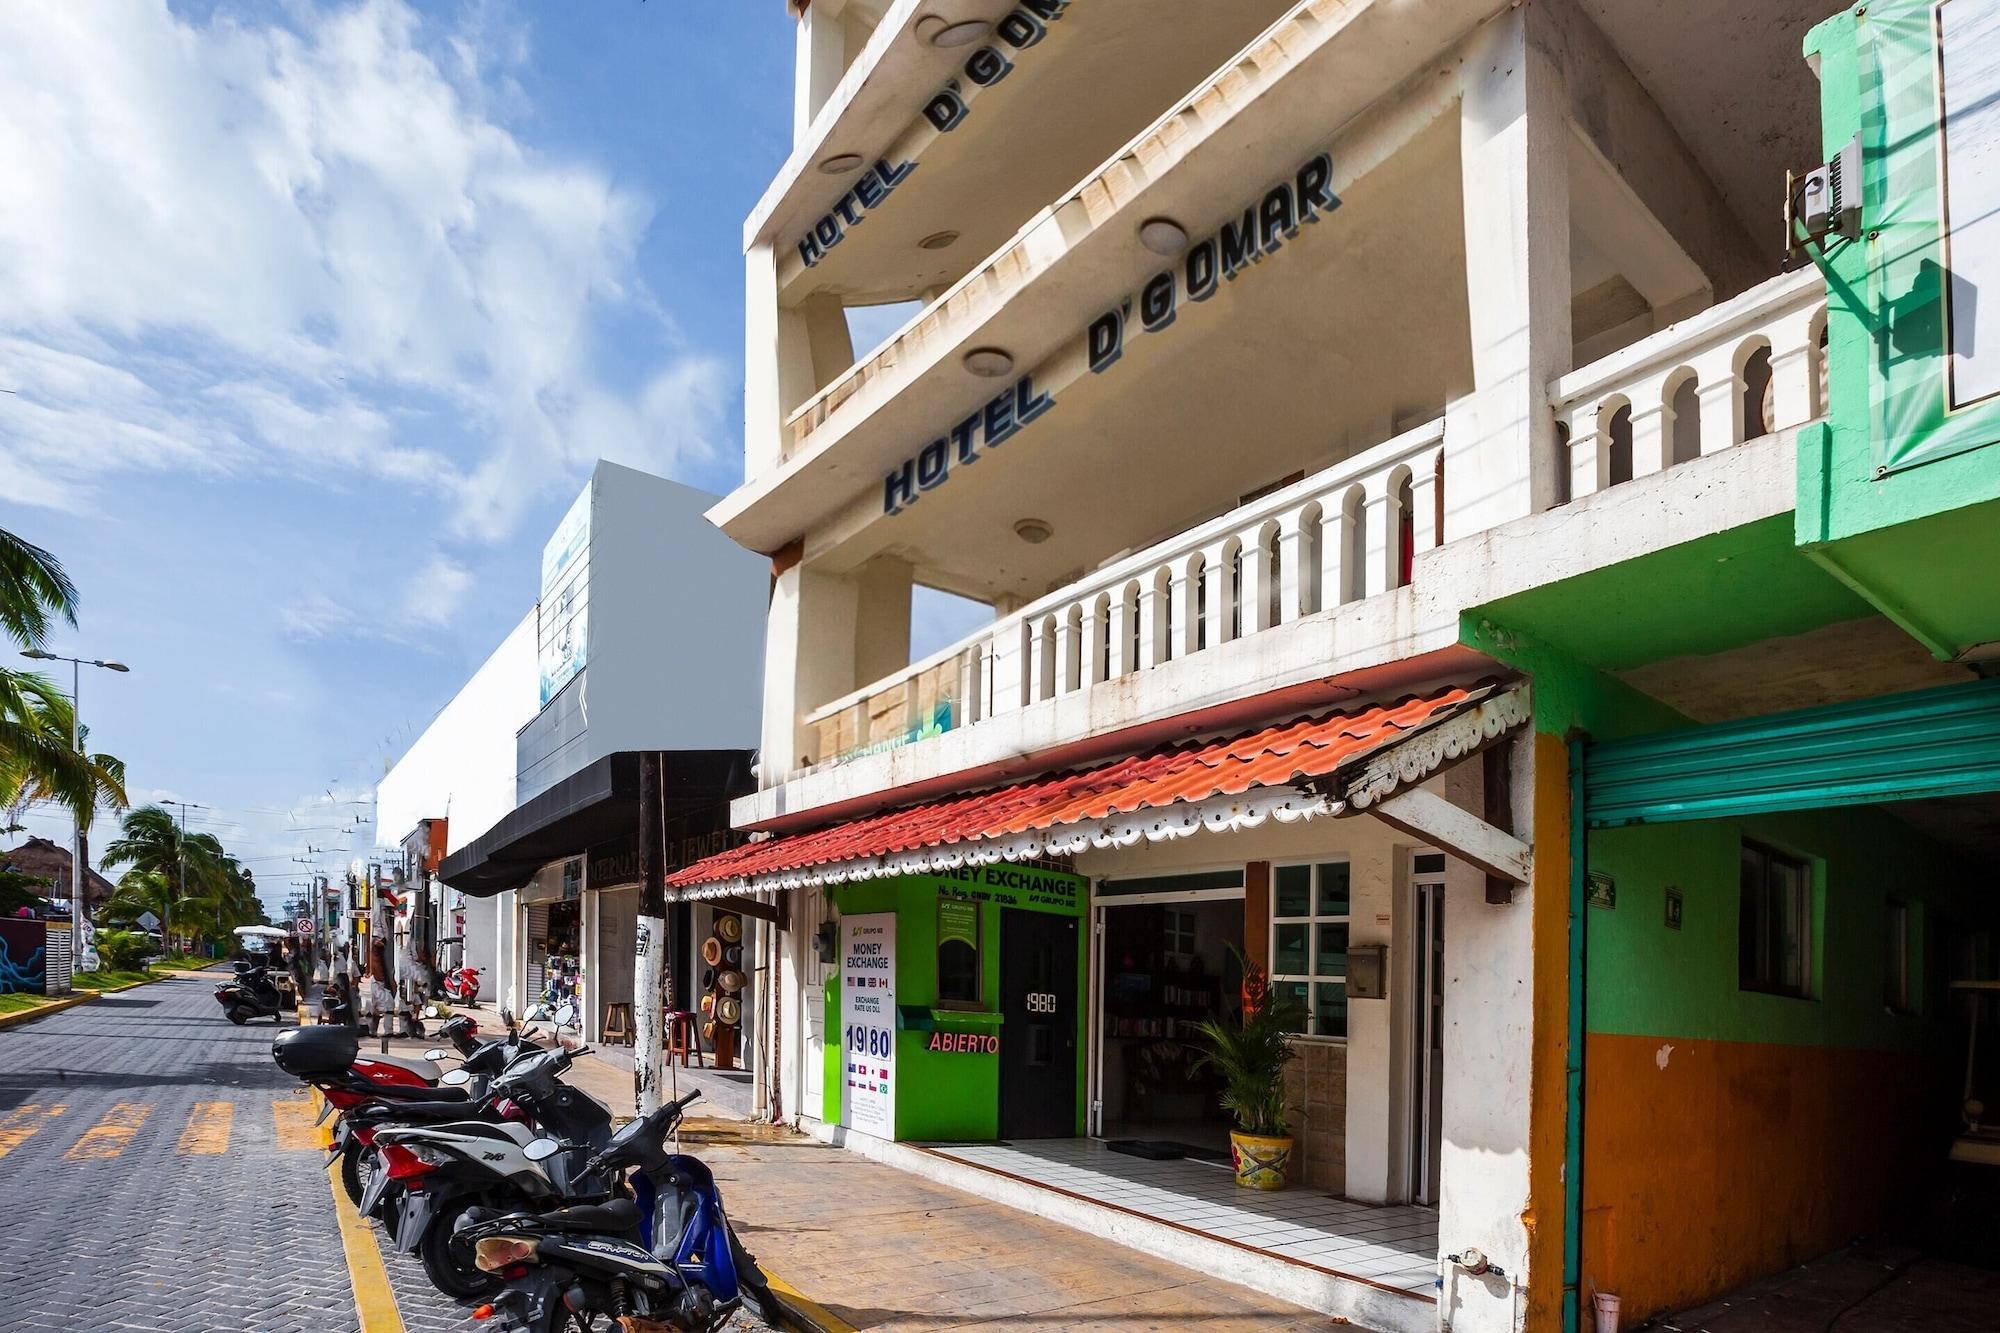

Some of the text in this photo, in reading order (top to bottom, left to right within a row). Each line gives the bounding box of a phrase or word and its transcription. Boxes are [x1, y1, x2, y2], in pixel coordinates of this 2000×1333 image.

[798, 157, 918, 269] HOTEL
[883, 152, 1344, 516] HOTEL D'GOMAR
[985, 868, 1077, 897] EXCHANGE
[1040, 895, 1065, 906] GRUPO
[853, 943, 882, 955] MONEY
[847, 956, 889, 969] EXCHANGE
[855, 996, 880, 1005] EXCHANGE
[854, 1004, 881, 1014] RATE US DLL
[929, 1032, 1000, 1055] ABIERTO
